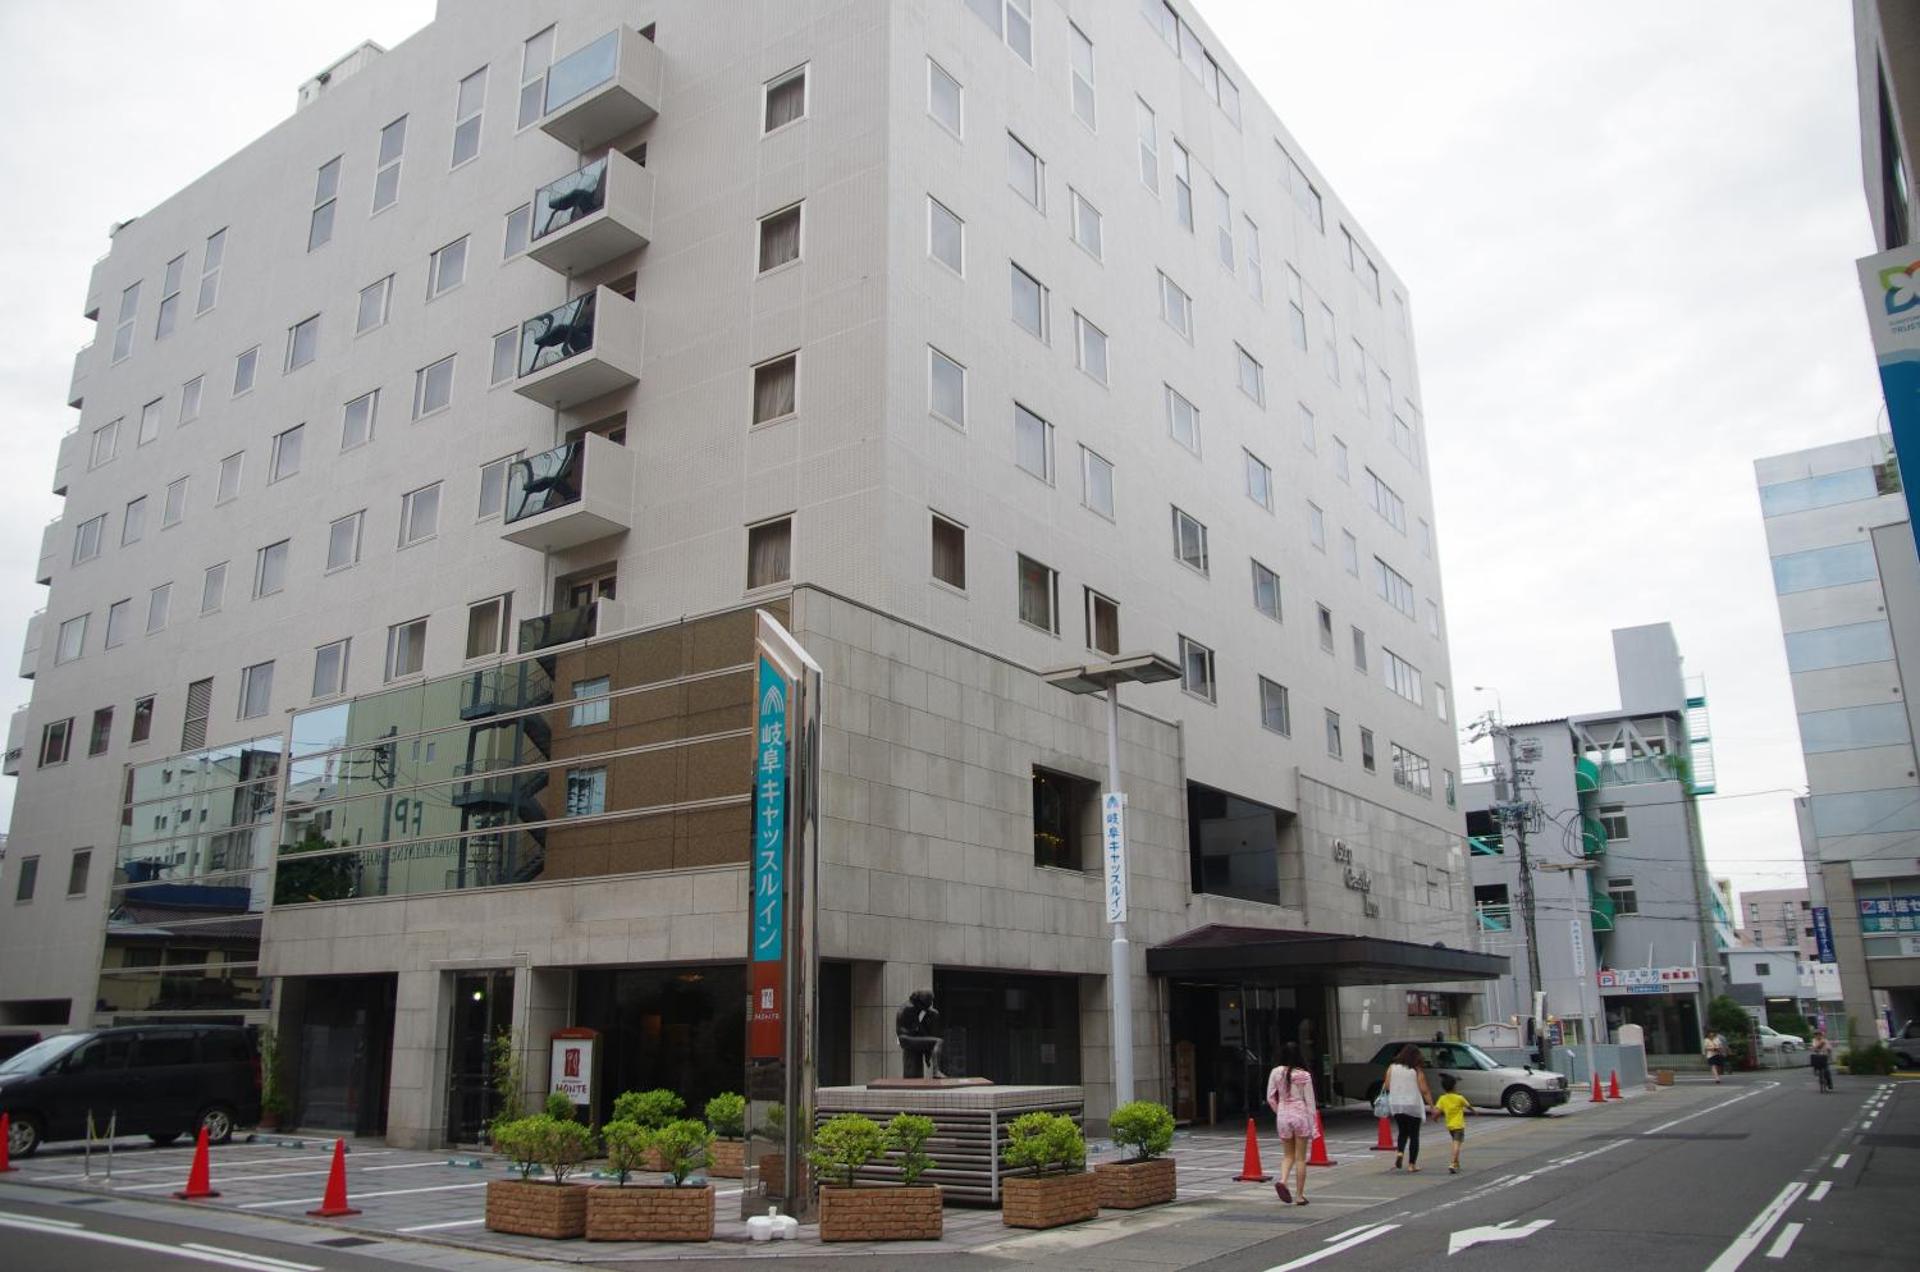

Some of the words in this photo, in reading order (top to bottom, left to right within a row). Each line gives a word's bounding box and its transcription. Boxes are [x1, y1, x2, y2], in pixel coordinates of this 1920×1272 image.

[759, 723, 782, 949] 岐阜キャッスルイン
[1106, 812, 1122, 921] 岐阜キャッスルイン
